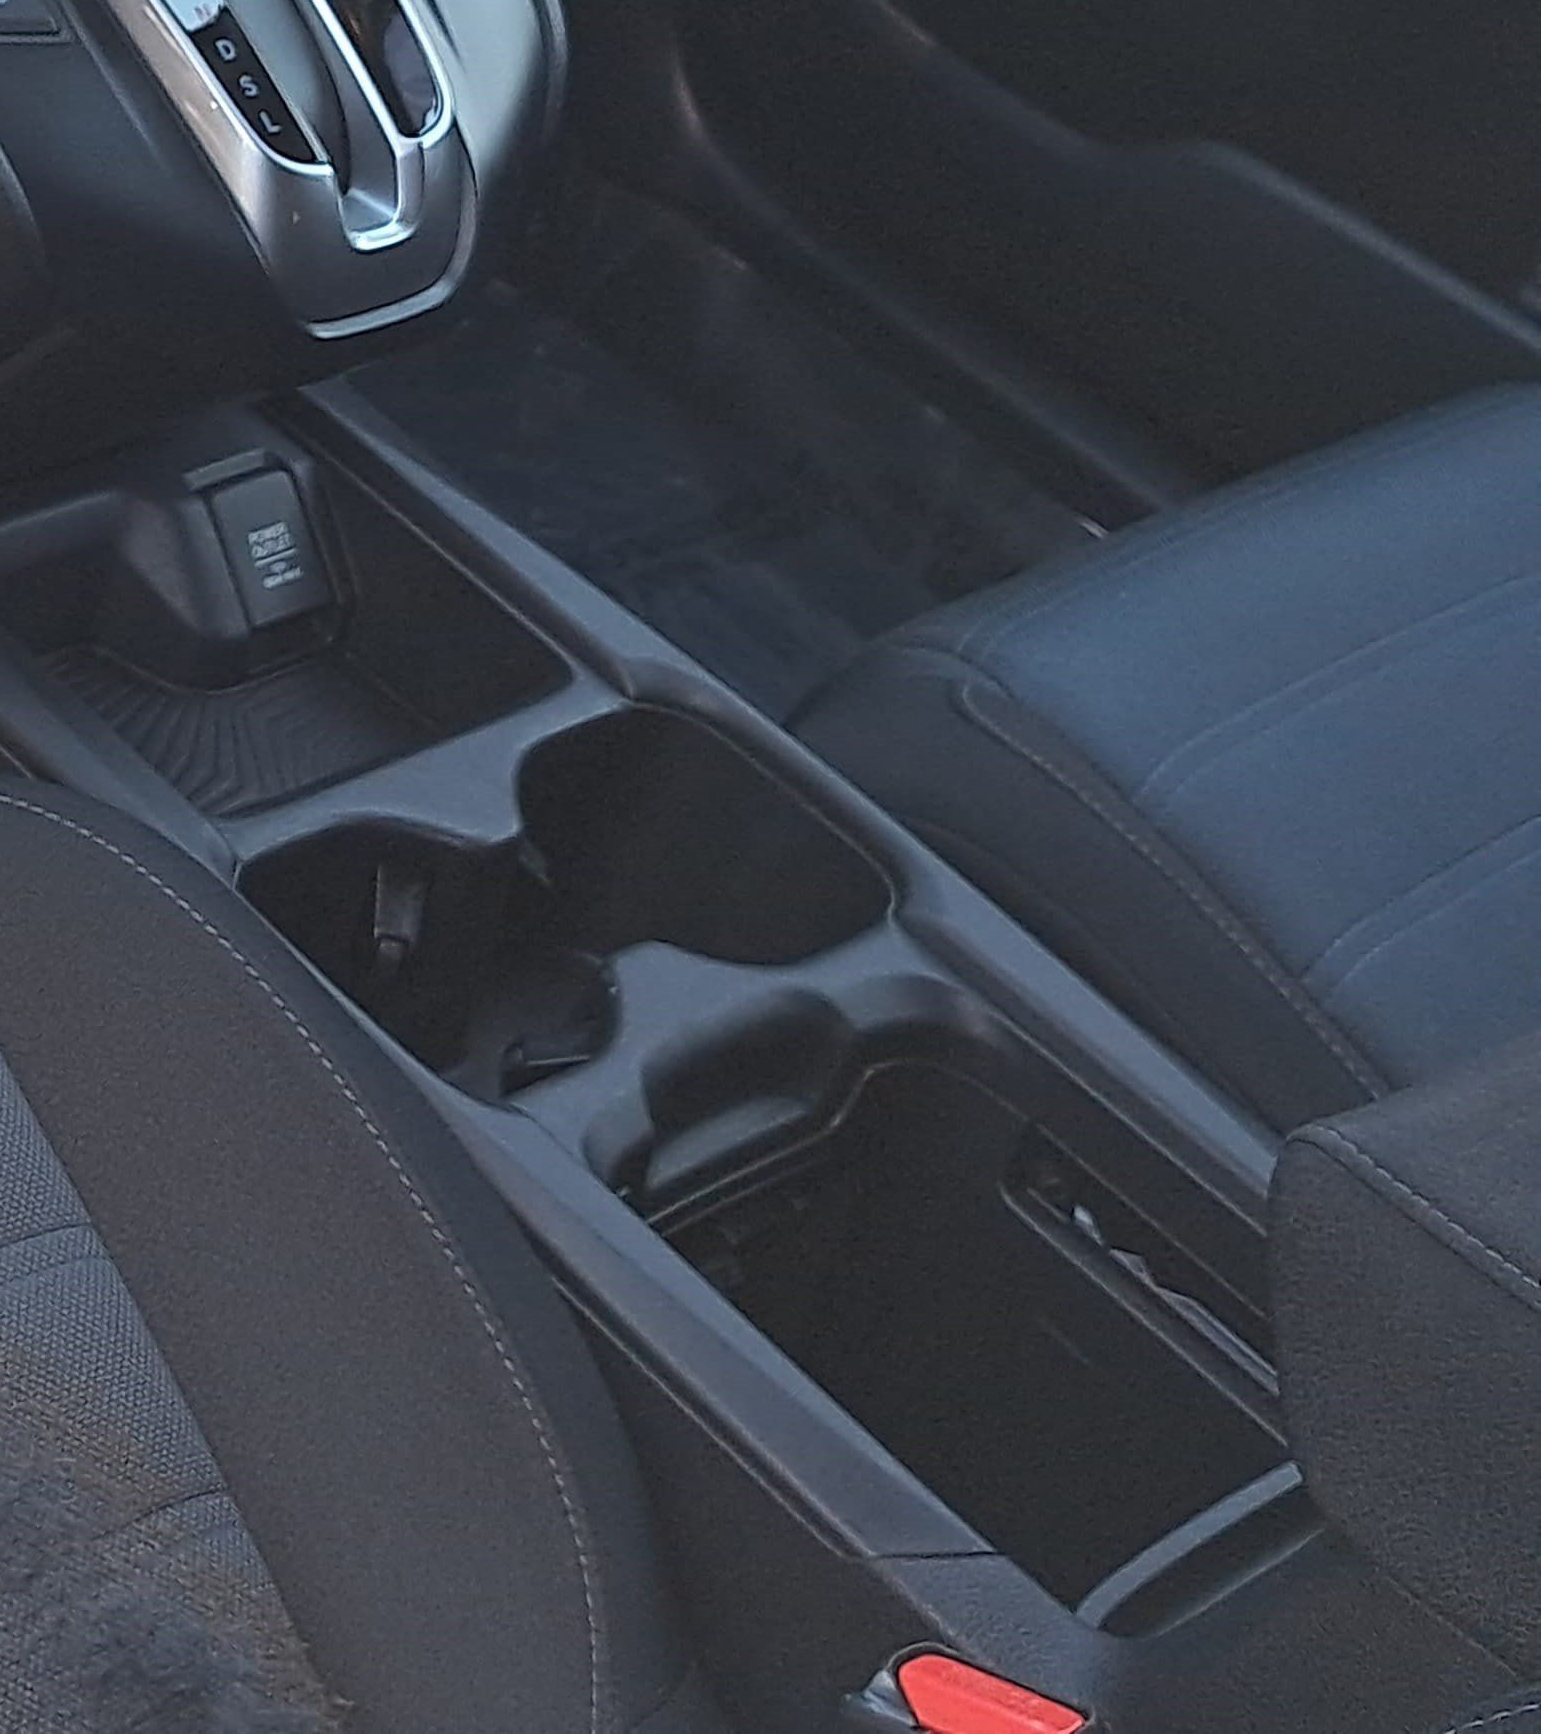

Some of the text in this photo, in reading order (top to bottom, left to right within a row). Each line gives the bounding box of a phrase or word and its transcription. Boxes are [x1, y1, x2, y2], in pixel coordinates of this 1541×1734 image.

[215, 37, 237, 62] D
[238, 73, 260, 98] S
[258, 110, 284, 135] L
